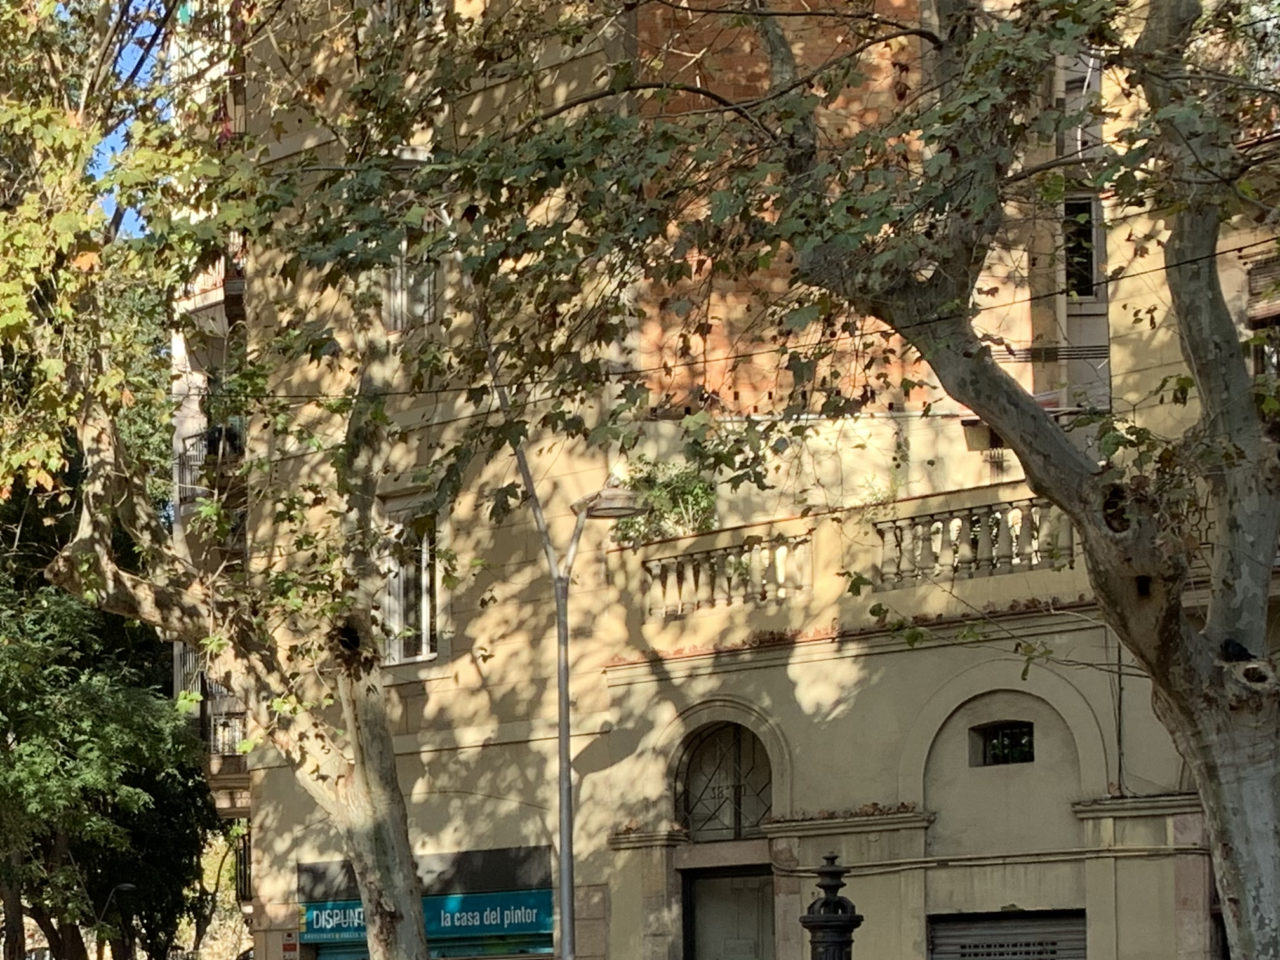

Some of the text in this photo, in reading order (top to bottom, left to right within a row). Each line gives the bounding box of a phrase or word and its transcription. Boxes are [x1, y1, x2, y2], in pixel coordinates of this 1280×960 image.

[441, 905, 538, 928] la casa del pintor
